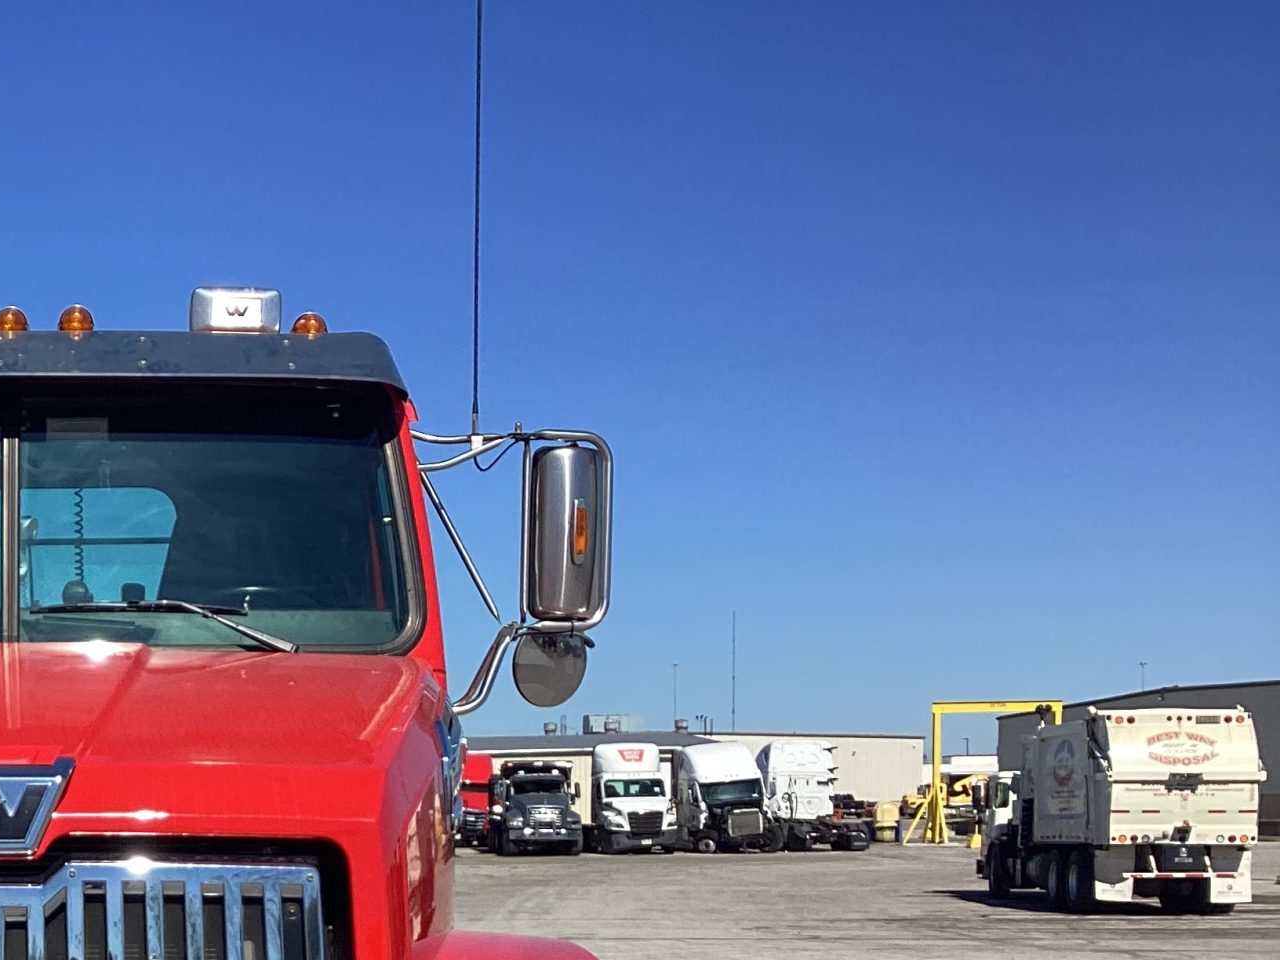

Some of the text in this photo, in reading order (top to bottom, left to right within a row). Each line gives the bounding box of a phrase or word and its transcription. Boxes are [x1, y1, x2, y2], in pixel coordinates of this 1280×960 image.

[1146, 731, 1219, 746] BEST WAY
[1148, 750, 1221, 767] DISPOSAL
